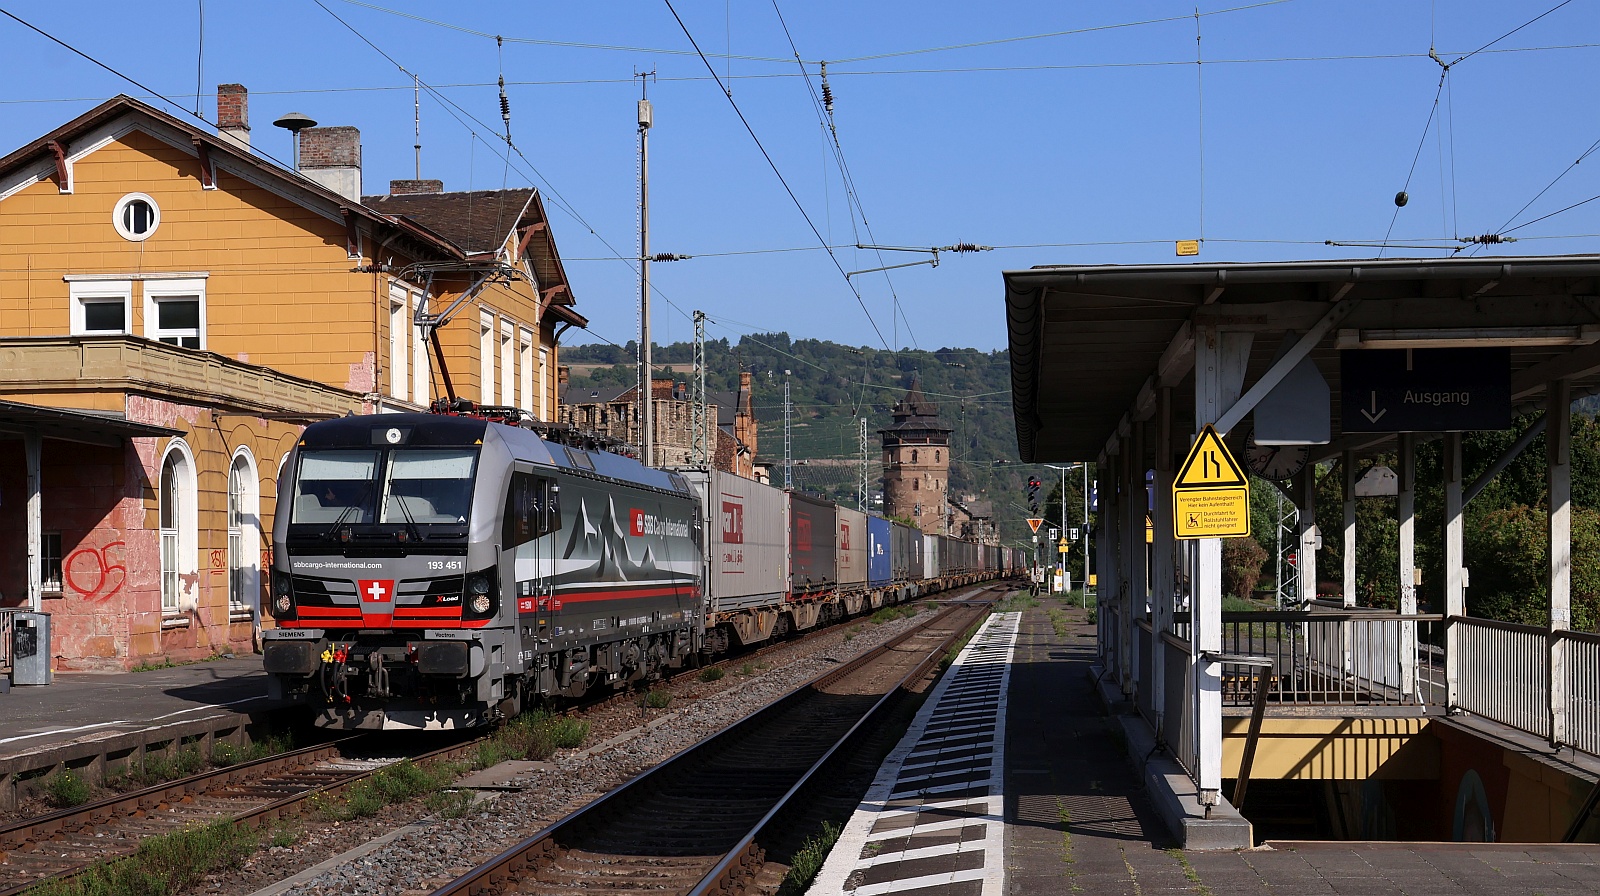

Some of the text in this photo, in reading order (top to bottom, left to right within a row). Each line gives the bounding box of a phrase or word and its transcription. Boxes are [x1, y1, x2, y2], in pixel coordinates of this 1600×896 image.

[1403, 390, 1470, 406] Ausgang
[644, 514, 689, 540] SBB Cargo International
[293, 561, 383, 570] sbbcargo-international.com
[427, 561, 462, 570] 193 451
